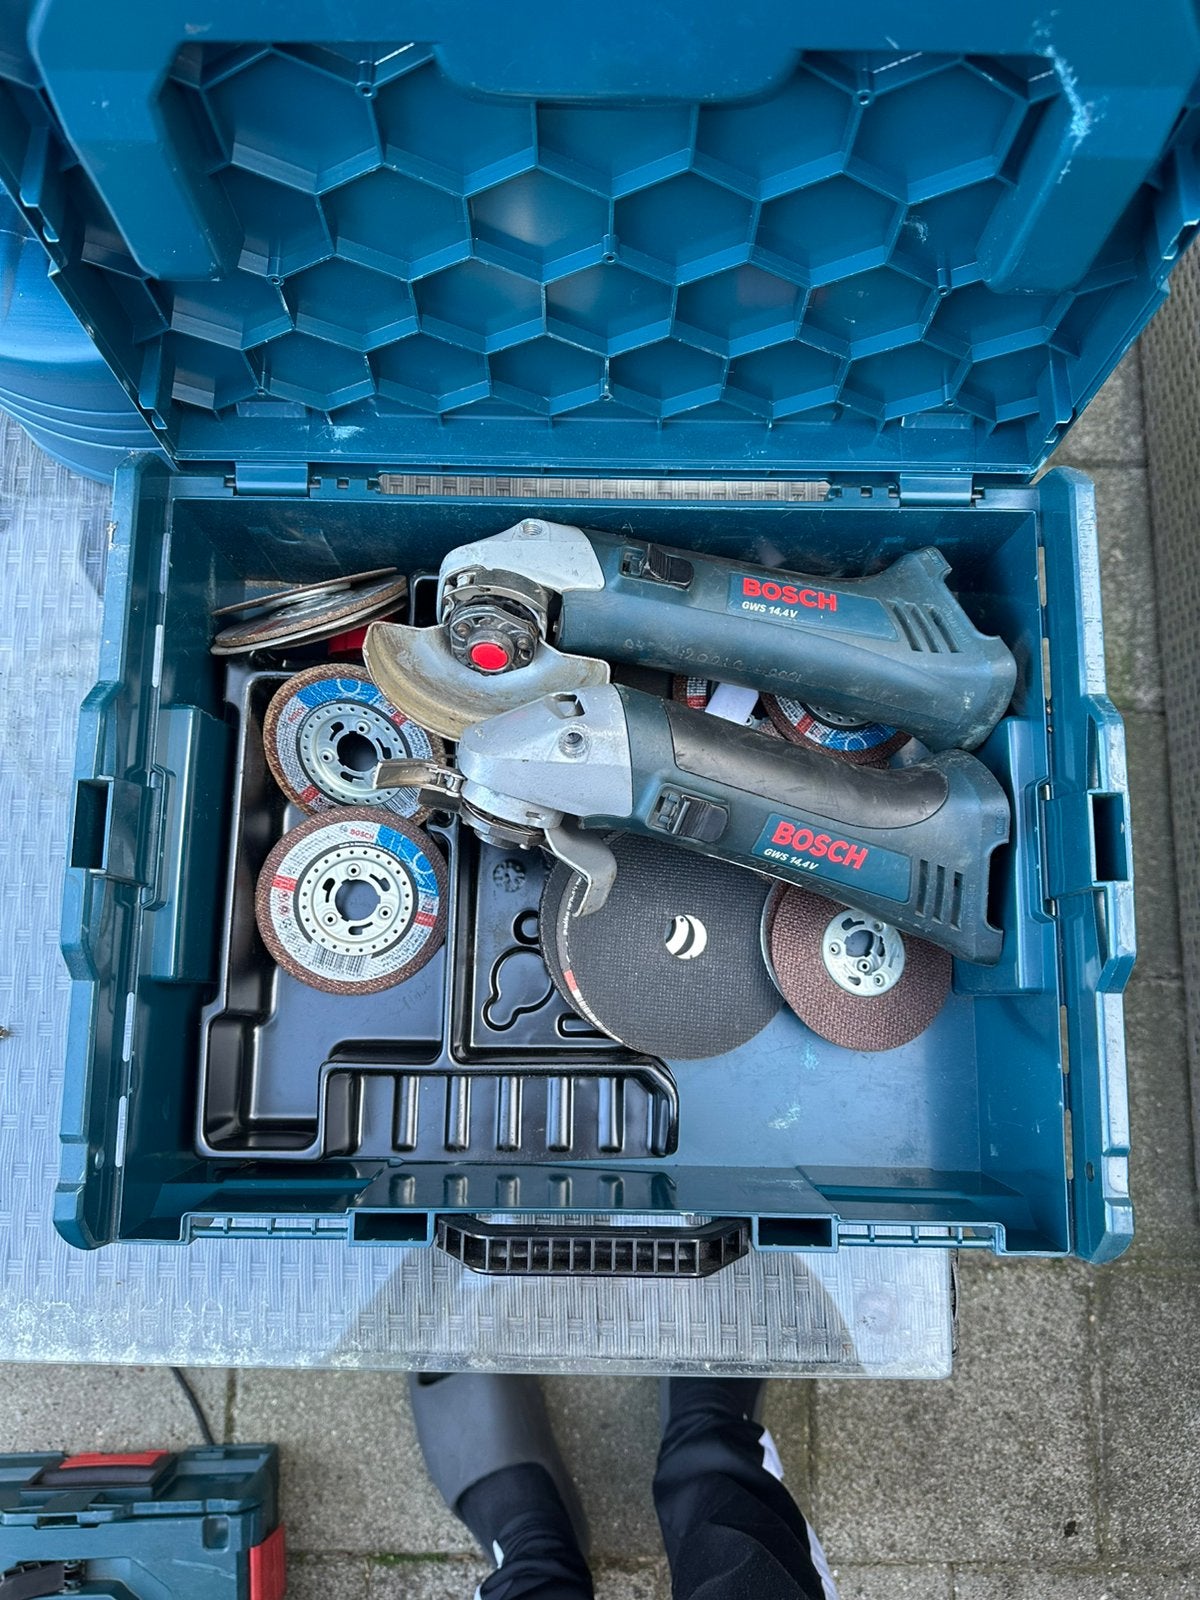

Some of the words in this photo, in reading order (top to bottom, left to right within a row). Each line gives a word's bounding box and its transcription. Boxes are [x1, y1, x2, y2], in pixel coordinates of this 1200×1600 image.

[743, 578, 837, 611] BOSCH
[742, 602, 766, 612] GWS
[769, 606, 798, 618] 14,4V
[350, 828, 375, 840] BOSCH
[772, 821, 868, 869] BOSCH
[764, 849, 788, 860] GWS
[790, 856, 818, 869] 14,4V
